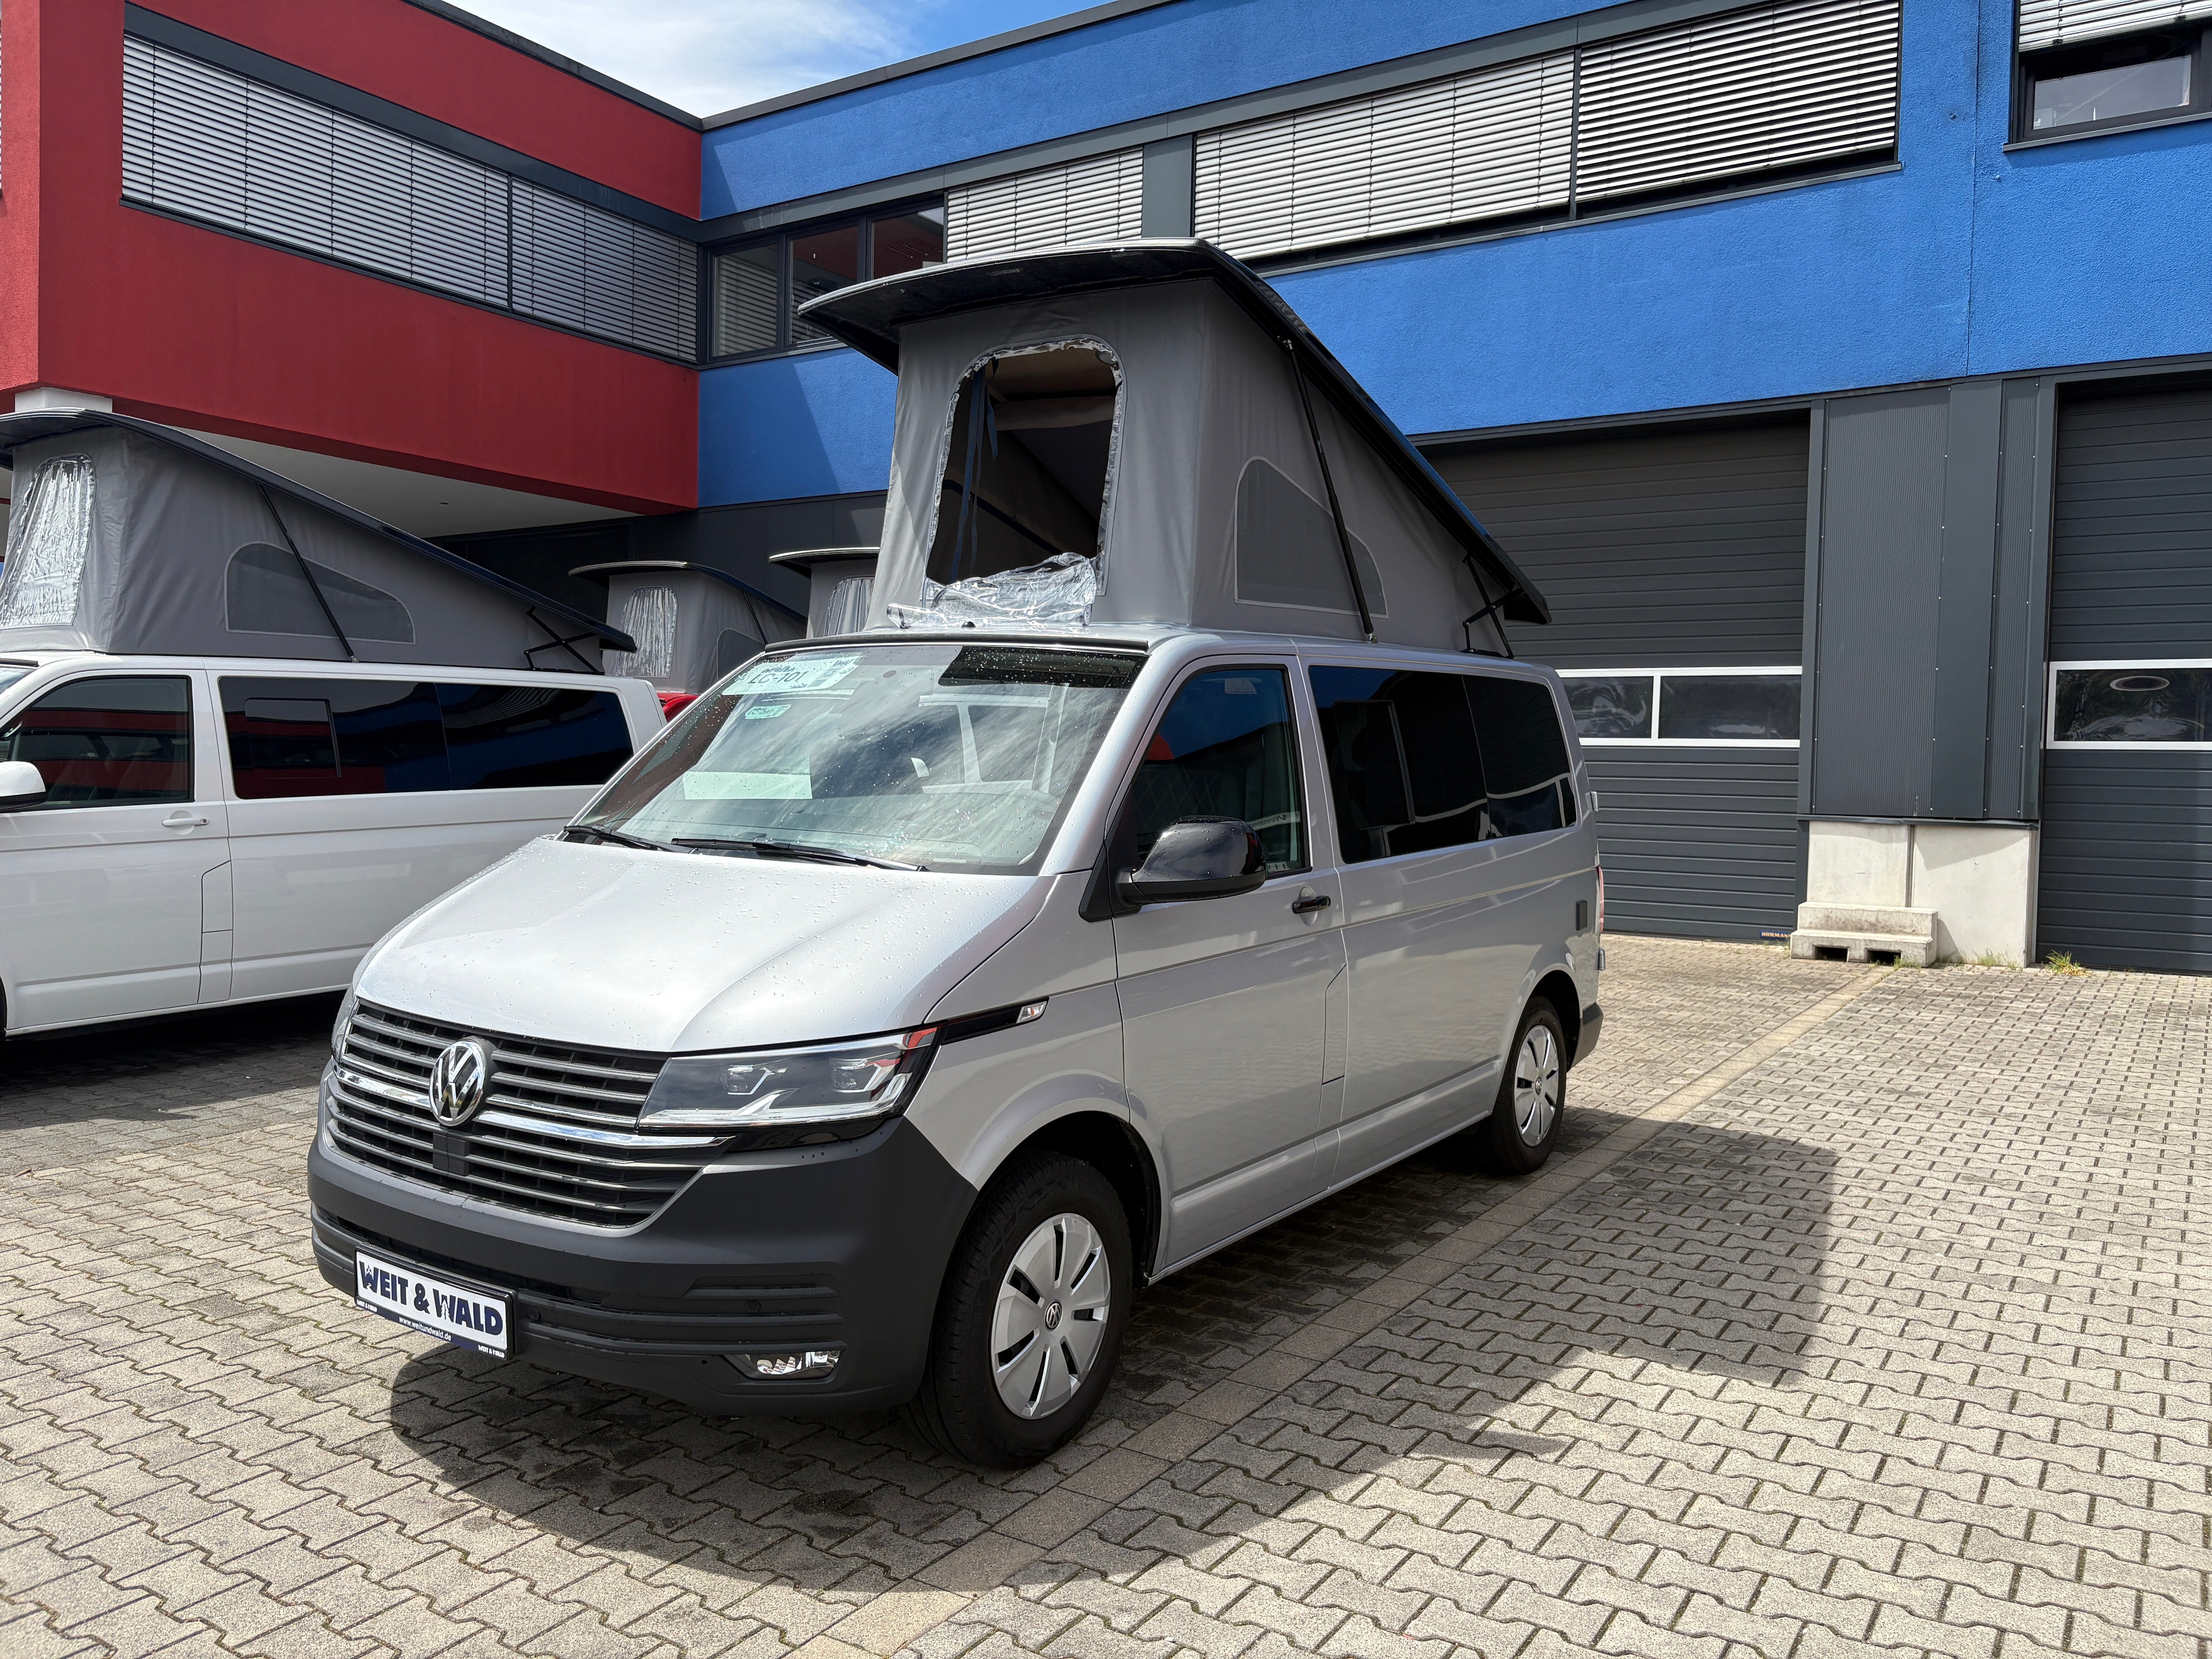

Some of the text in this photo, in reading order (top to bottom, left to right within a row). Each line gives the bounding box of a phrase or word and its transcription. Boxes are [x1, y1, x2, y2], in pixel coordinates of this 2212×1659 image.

[429, 1041, 485, 1126] VW
[359, 1261, 503, 1336] WEIT & WALD
[399, 1316, 452, 1341] www.weitundwald.de
